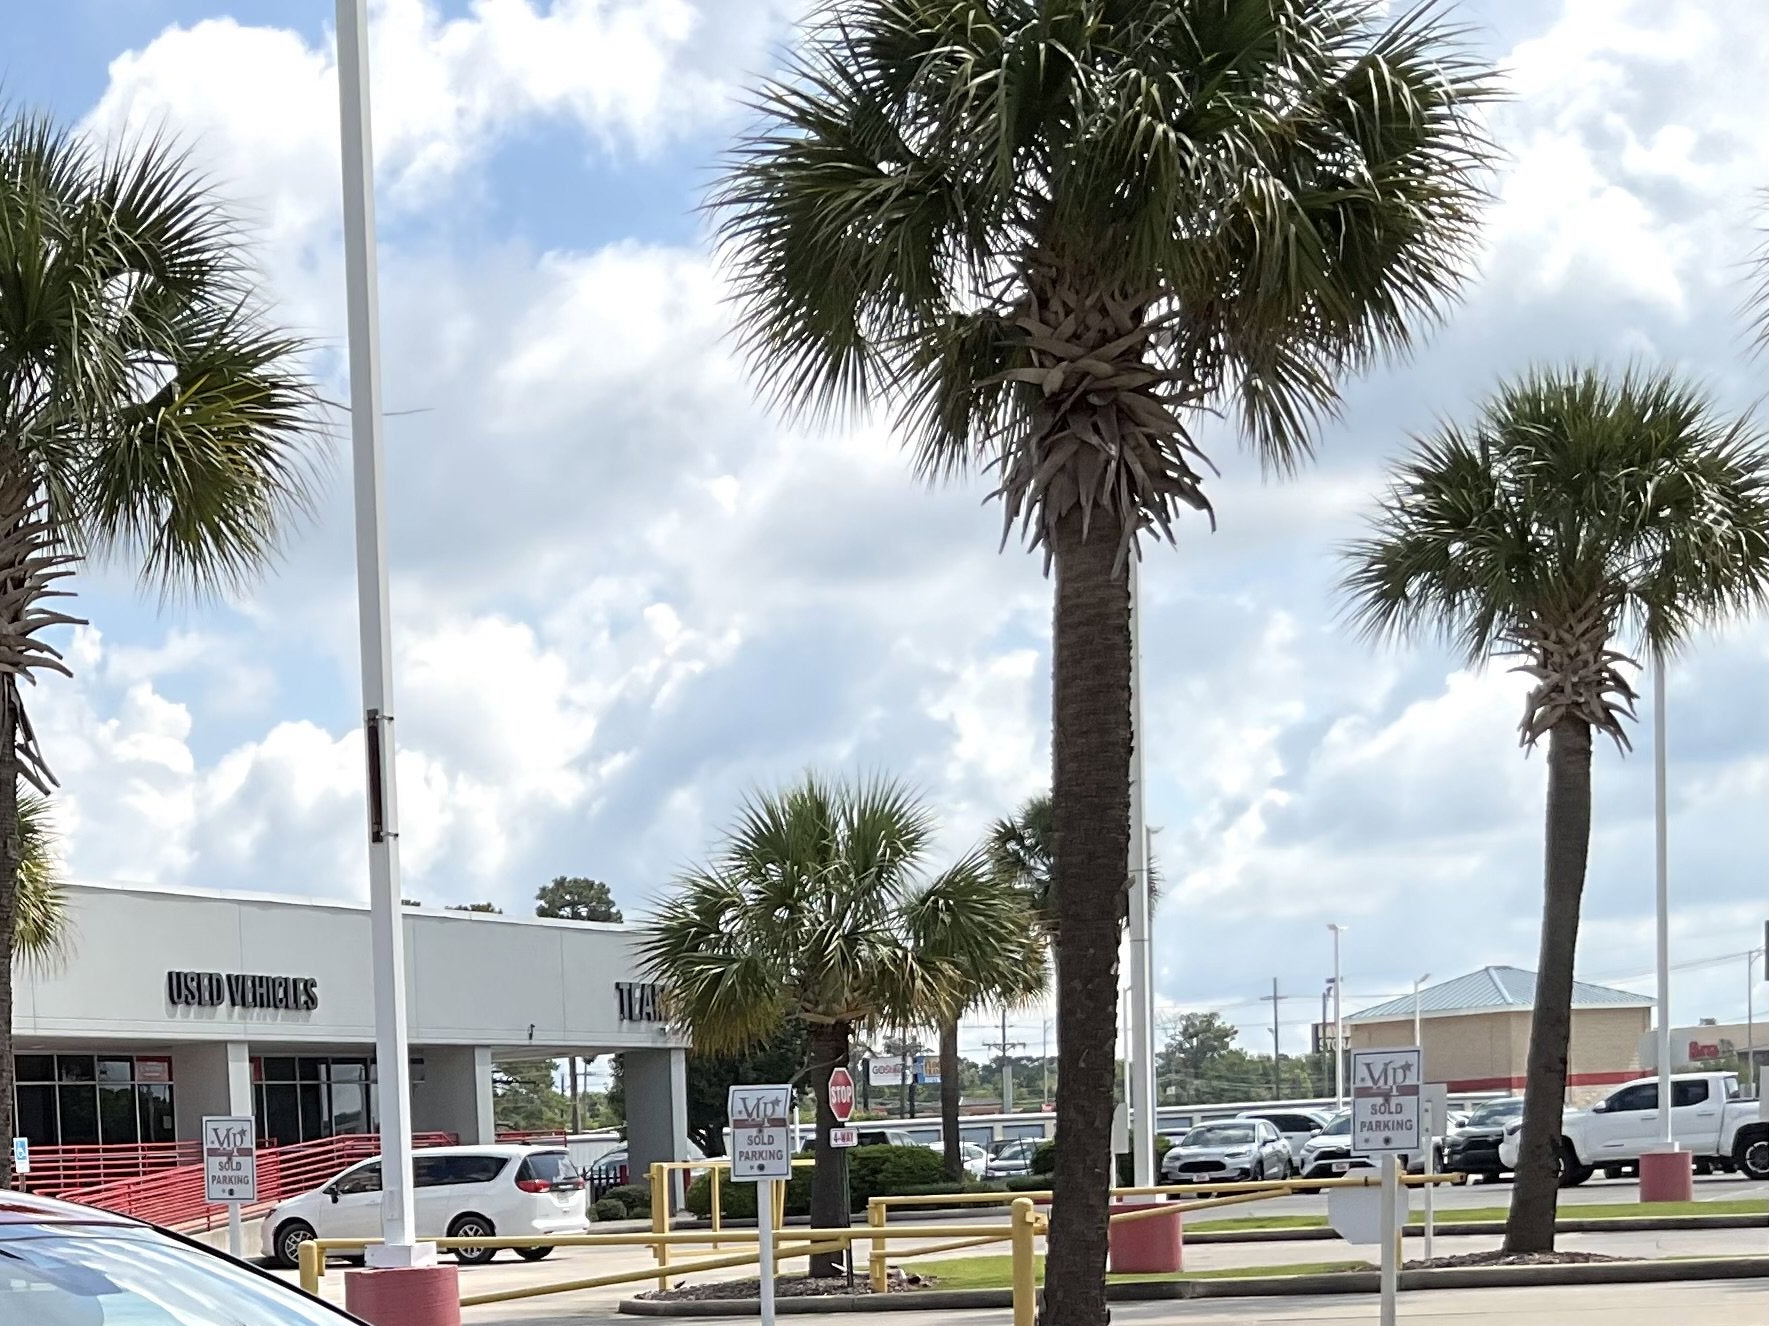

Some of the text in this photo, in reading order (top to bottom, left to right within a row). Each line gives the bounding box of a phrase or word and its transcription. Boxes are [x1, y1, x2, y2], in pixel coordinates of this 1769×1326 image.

[167, 971, 319, 1011] USED VEHICLES
[831, 1086, 852, 1104] STOP
[1370, 1103, 1403, 1115] SOLD
[1359, 1119, 1413, 1132] PARKING
[747, 1134, 775, 1146] SOLD
[833, 1132, 854, 1143] 4-WAY
[738, 1149, 784, 1161] PARKING
[218, 1161, 242, 1171] SOLD
[212, 1174, 249, 1185] PARKING
